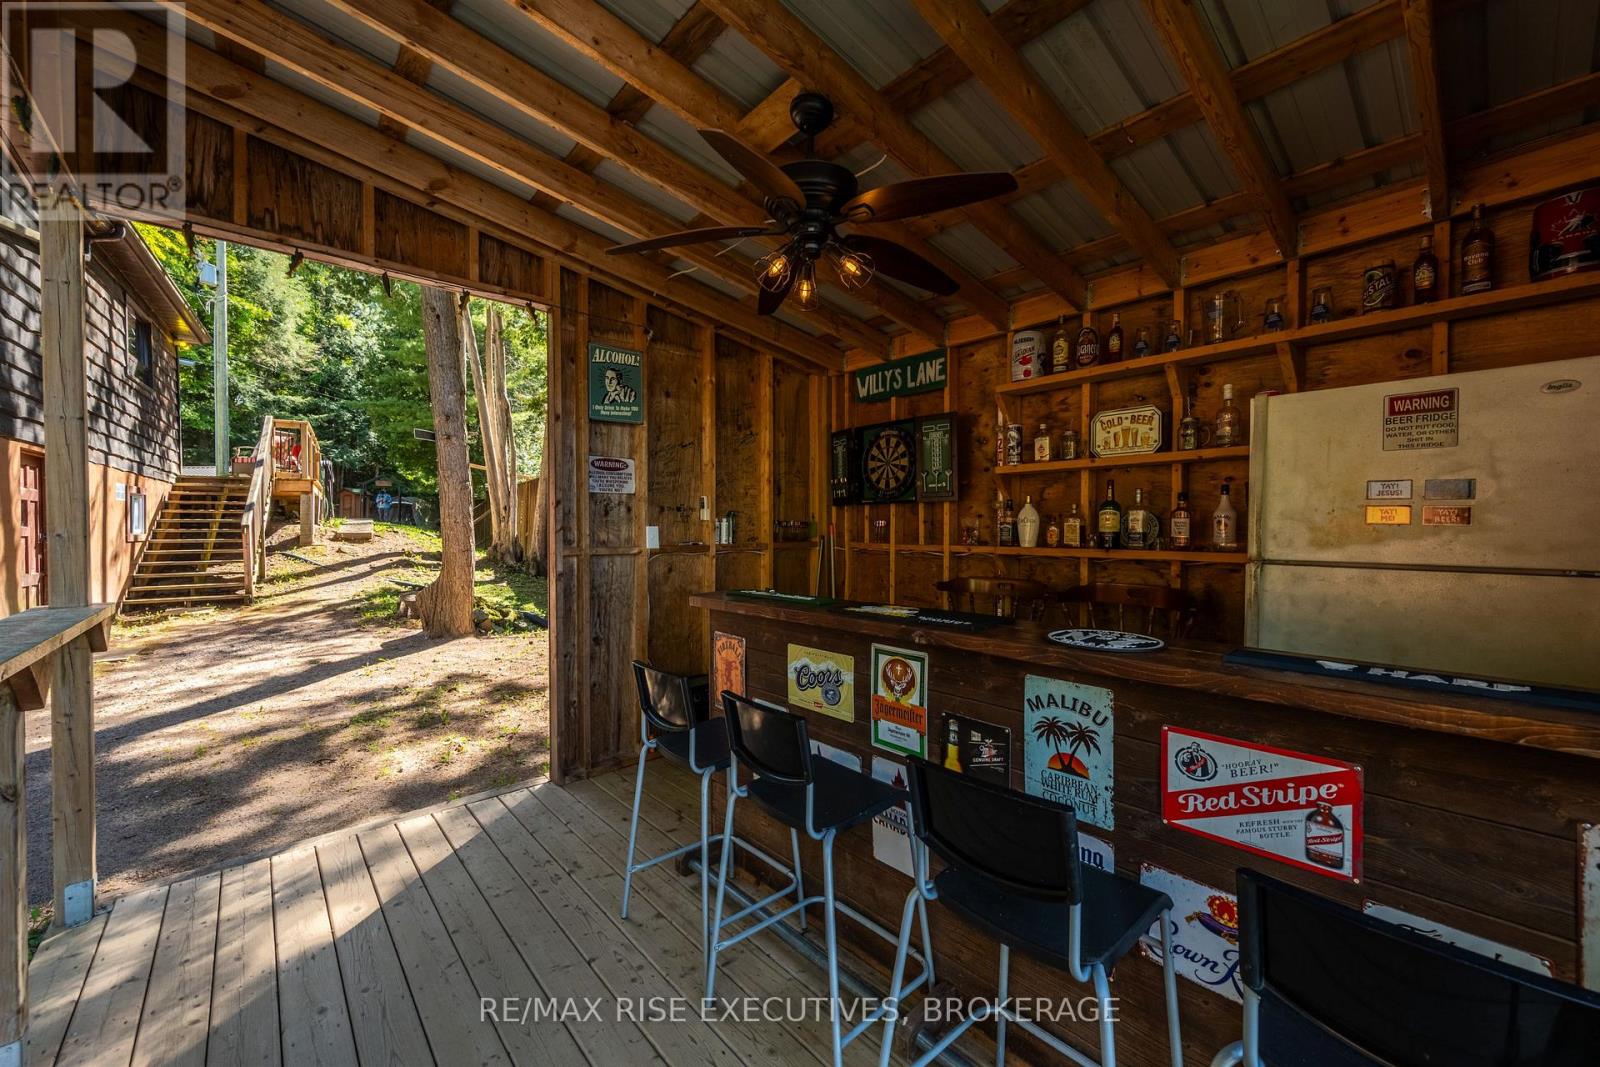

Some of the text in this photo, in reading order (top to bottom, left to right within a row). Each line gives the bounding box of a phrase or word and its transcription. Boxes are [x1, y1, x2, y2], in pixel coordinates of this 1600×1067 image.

[591, 347, 641, 367] ALCOHOL!
[856, 357, 946, 399] WILLY'S LANE
[1394, 395, 1450, 412] WARNING
[1100, 414, 1154, 431] COLD BEER
[1385, 411, 1456, 426] BEER FRIDGE
[1376, 489, 1402, 497] JESUS!
[1434, 515, 1460, 523] BEER!
[1438, 508, 1458, 516] YAY!
[794, 665, 844, 691] Coors
[1026, 693, 1109, 727] MALIBU
[1040, 769, 1098, 794] CARIBBEAN
[1041, 778, 1098, 804] WHITE RUM
[1042, 790, 1097, 819] COCONUT
[1177, 791, 1240, 813] Red
[1239, 819, 1280, 828] REFRESH
[1267, 825, 1298, 833] STUBBY
[1259, 831, 1291, 839] BOTTLE
